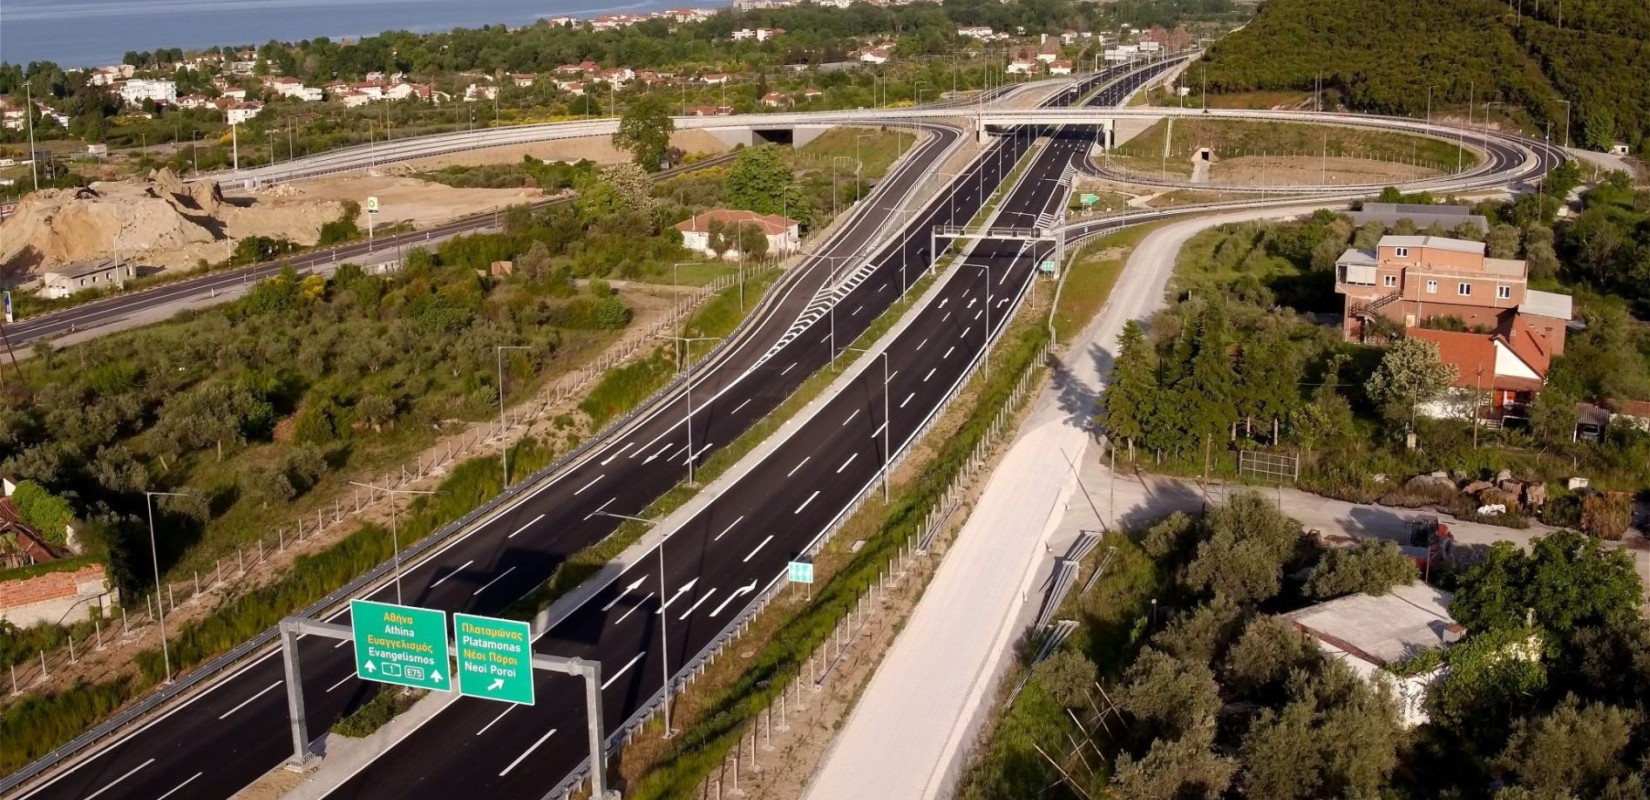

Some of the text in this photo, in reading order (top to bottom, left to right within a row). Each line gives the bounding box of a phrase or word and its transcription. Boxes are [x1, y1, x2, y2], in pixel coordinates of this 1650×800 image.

[383, 612, 413, 625] Αθήνα
[384, 625, 415, 638] Athina
[461, 622, 522, 640] Πλαταμώνας
[367, 635, 433, 654] Ευαγγελισμός
[462, 636, 521, 652] Platamonas
[368, 647, 435, 665] Evangelismos
[463, 649, 518, 666] Νέοι Πόροι
[389, 665, 394, 673] 1
[407, 668, 422, 678] E75
[464, 661, 516, 677] Neoi Poroi
